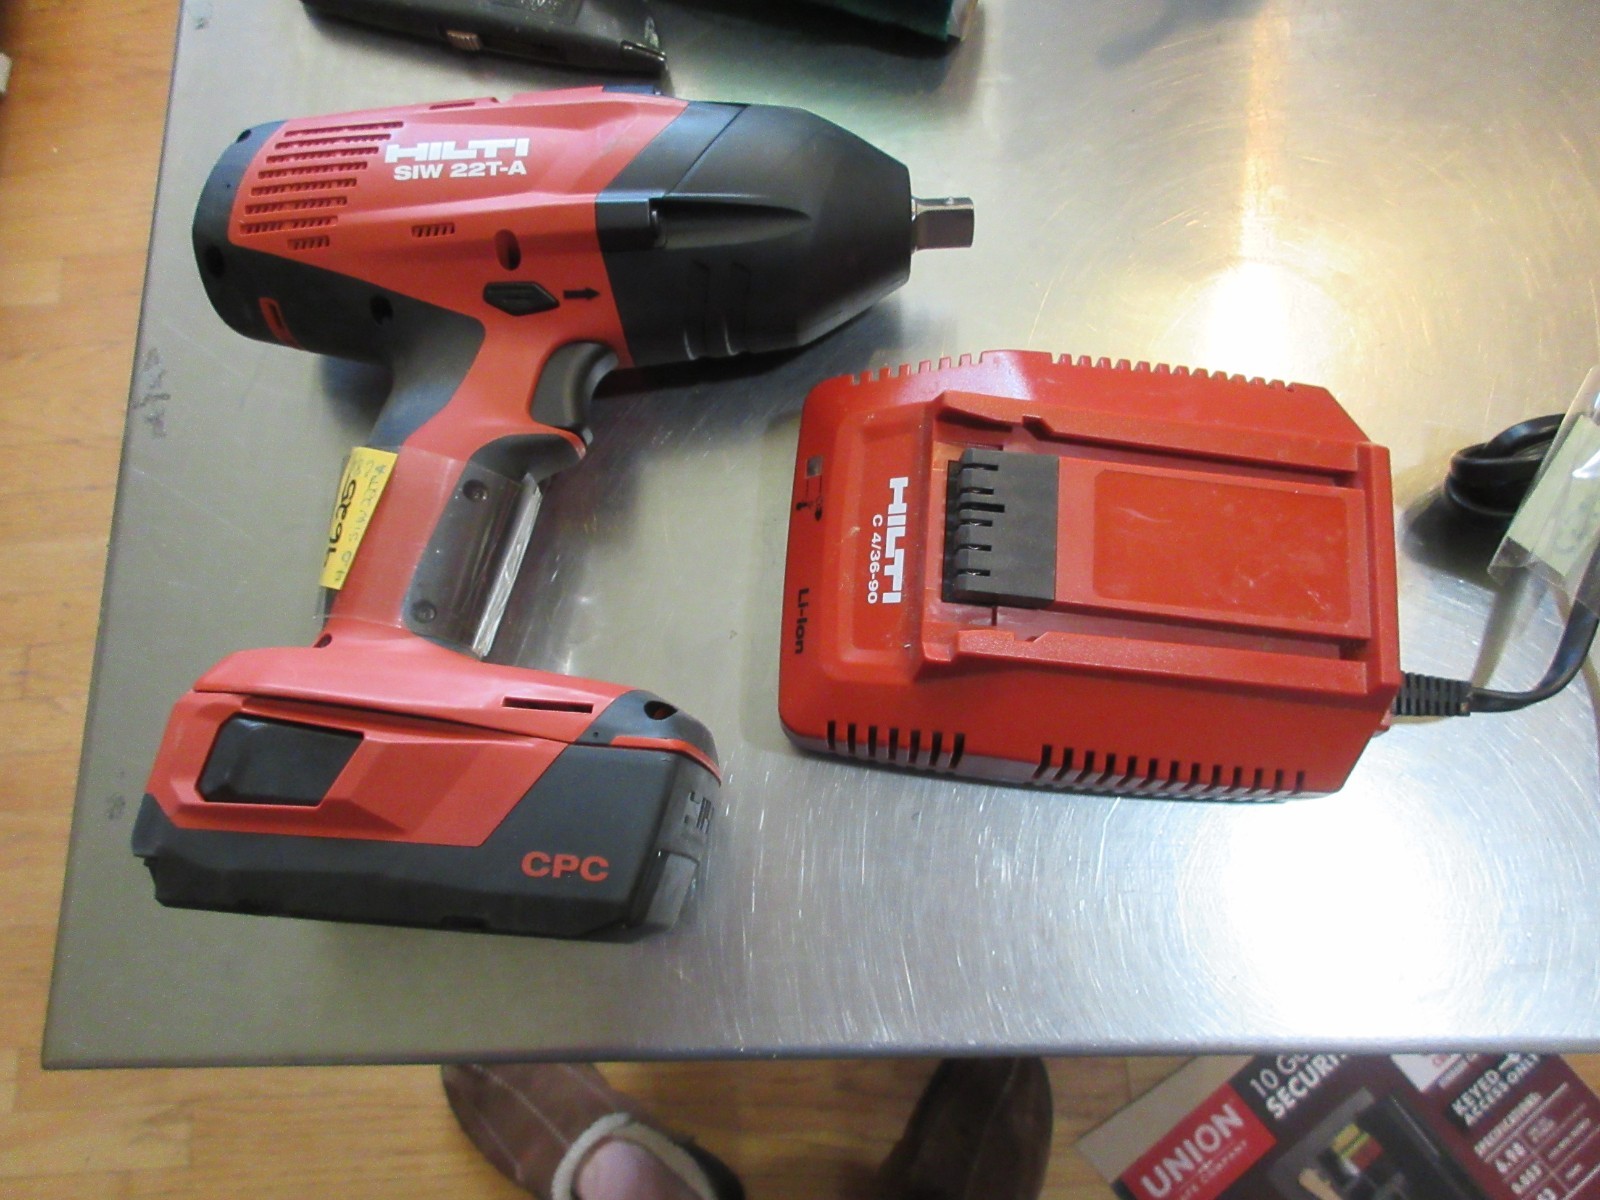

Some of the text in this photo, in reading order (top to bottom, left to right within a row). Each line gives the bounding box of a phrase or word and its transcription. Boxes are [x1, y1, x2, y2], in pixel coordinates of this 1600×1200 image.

[384, 138, 530, 163] HILTI
[393, 160, 527, 181] SIW 22T-A
[867, 514, 883, 604] C 4/36-90
[882, 476, 909, 603] HILTI
[521, 851, 609, 882] CPC
[1250, 1068, 1279, 1098] 10
[1451, 1069, 1500, 1117] KEYED
[1464, 1080, 1510, 1126] ACCESS
[1140, 1103, 1244, 1198] UNION
